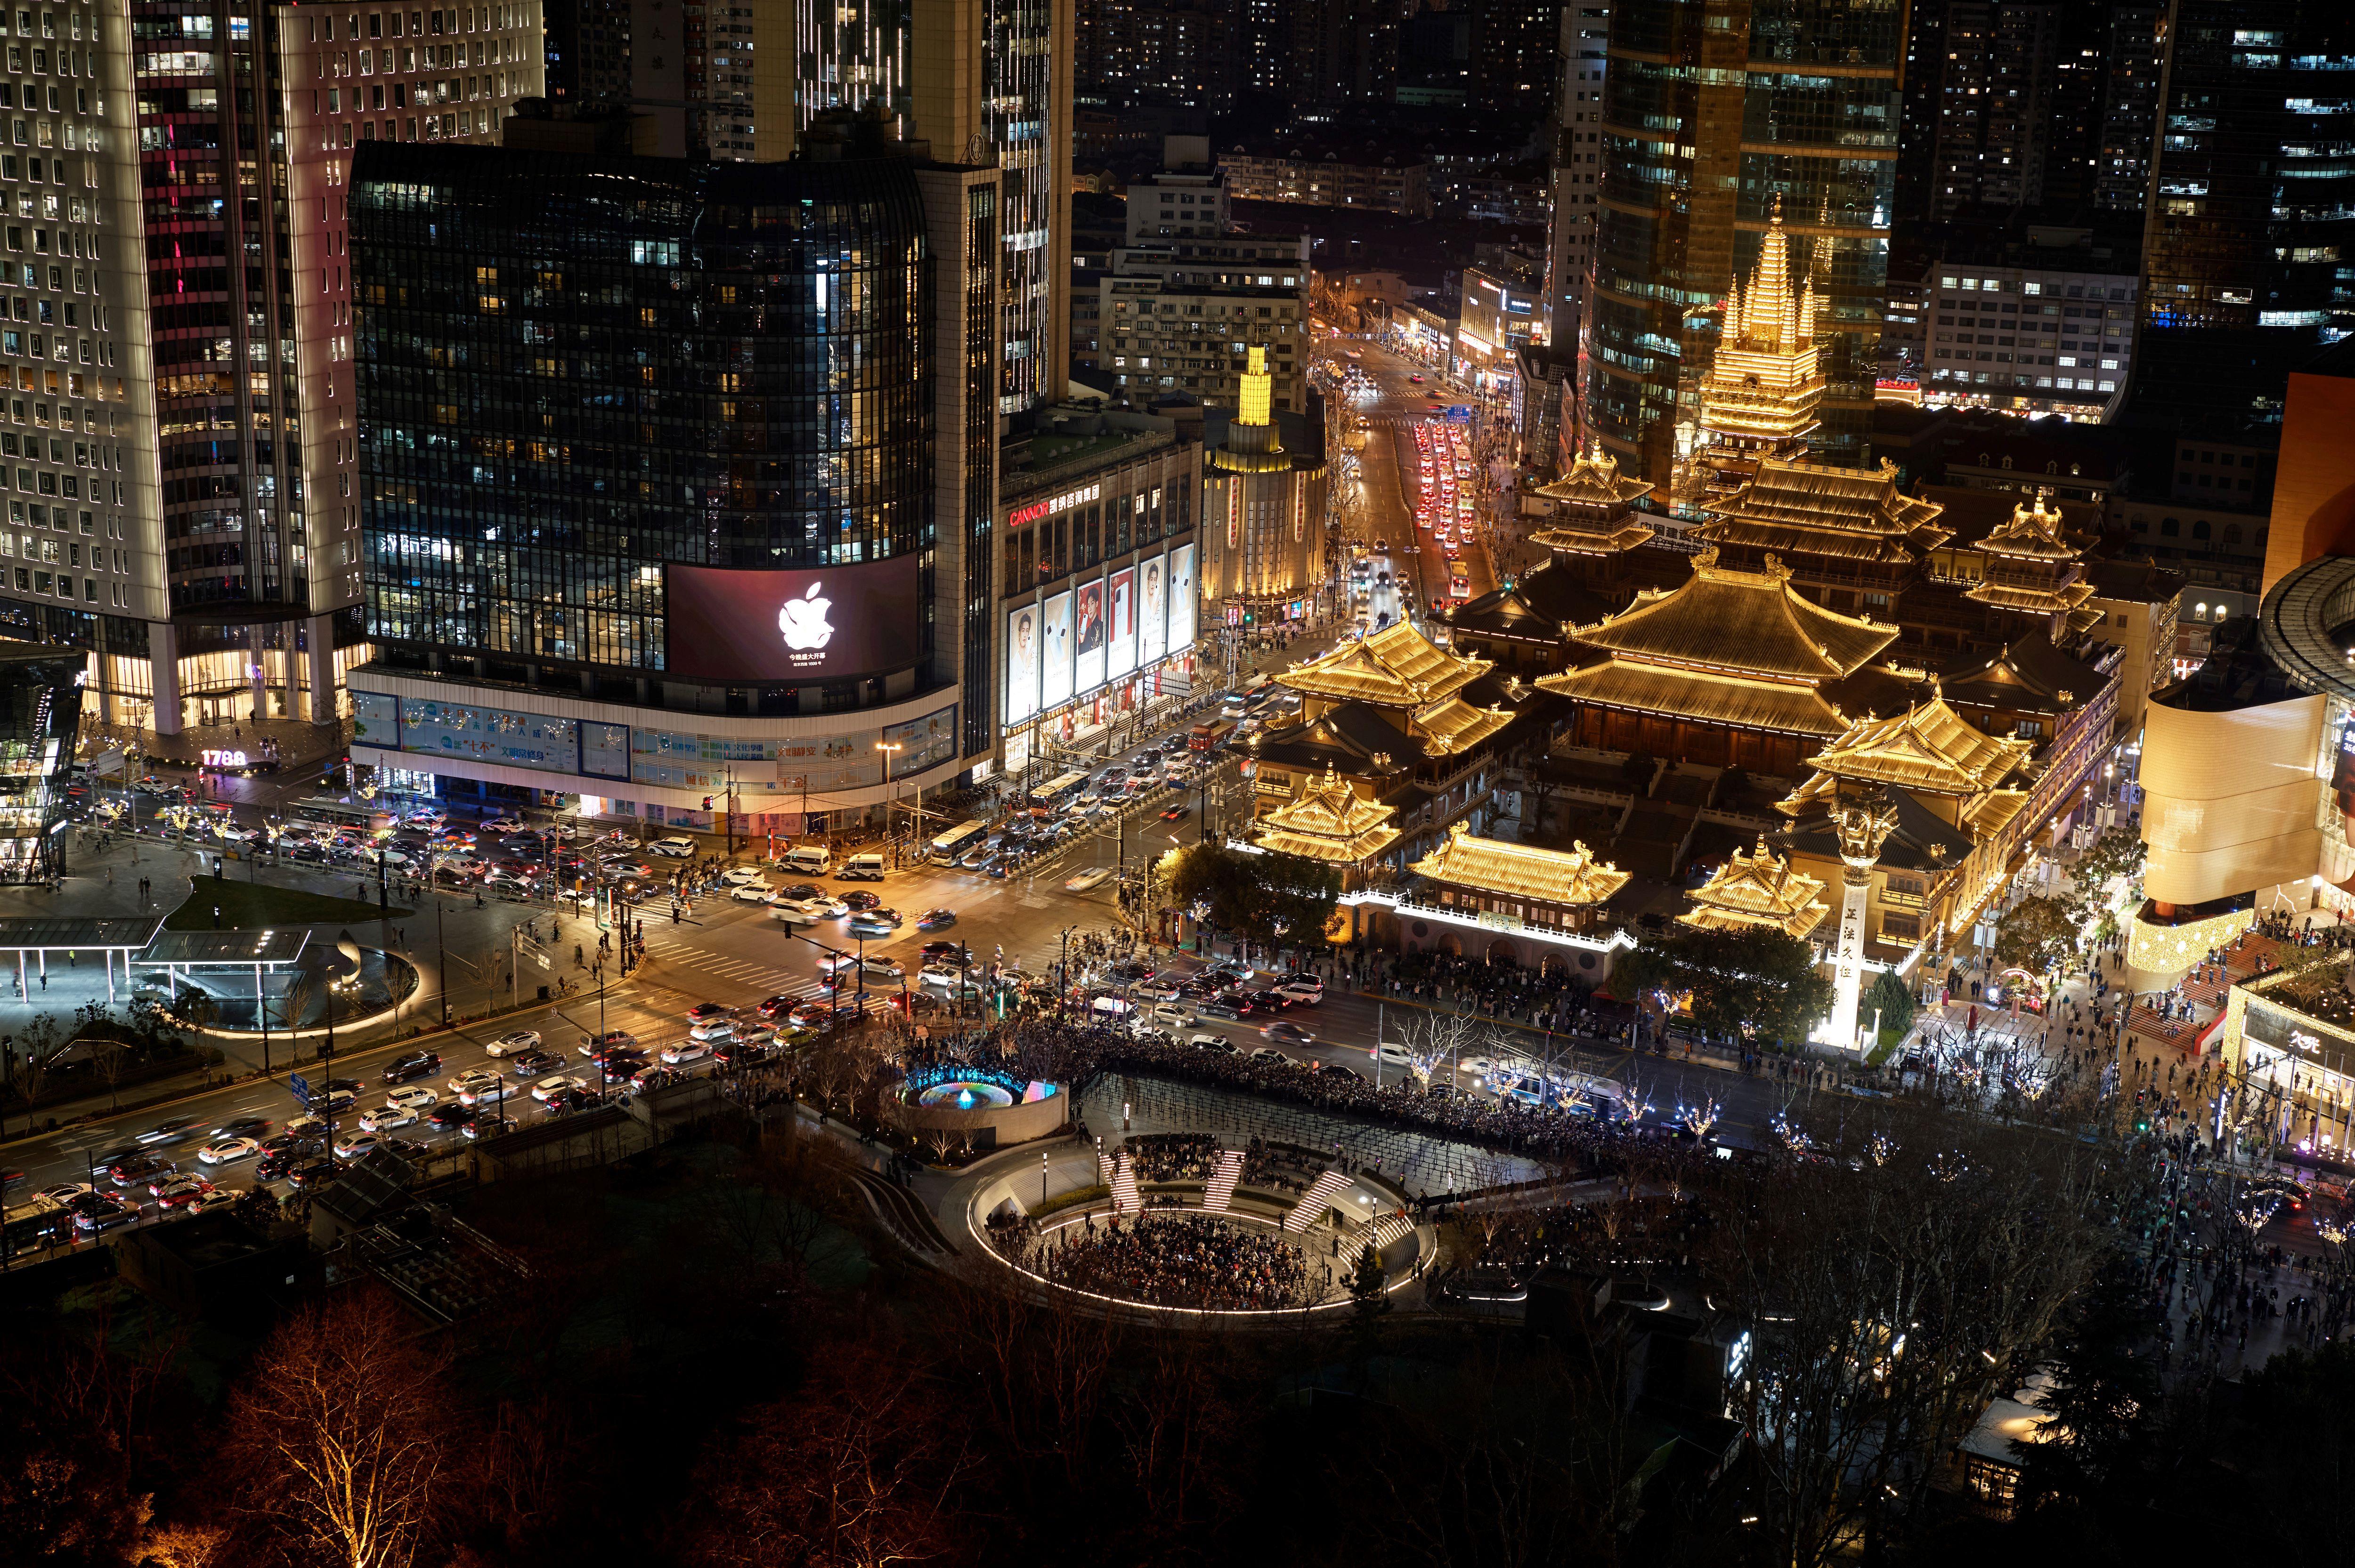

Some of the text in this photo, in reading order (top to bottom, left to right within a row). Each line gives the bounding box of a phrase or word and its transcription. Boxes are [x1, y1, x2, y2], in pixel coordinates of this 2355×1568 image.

[1010, 484, 1099, 527] CANNOR 凯纳咨询集团
[789, 652, 826, 661] 今晚盛大开幕
[201, 750, 246, 766] 1788
[502, 746, 544, 761] 文明常修身
[776, 746, 816, 757] 文明静安
[1840, 908, 1857, 978] 正法久住
